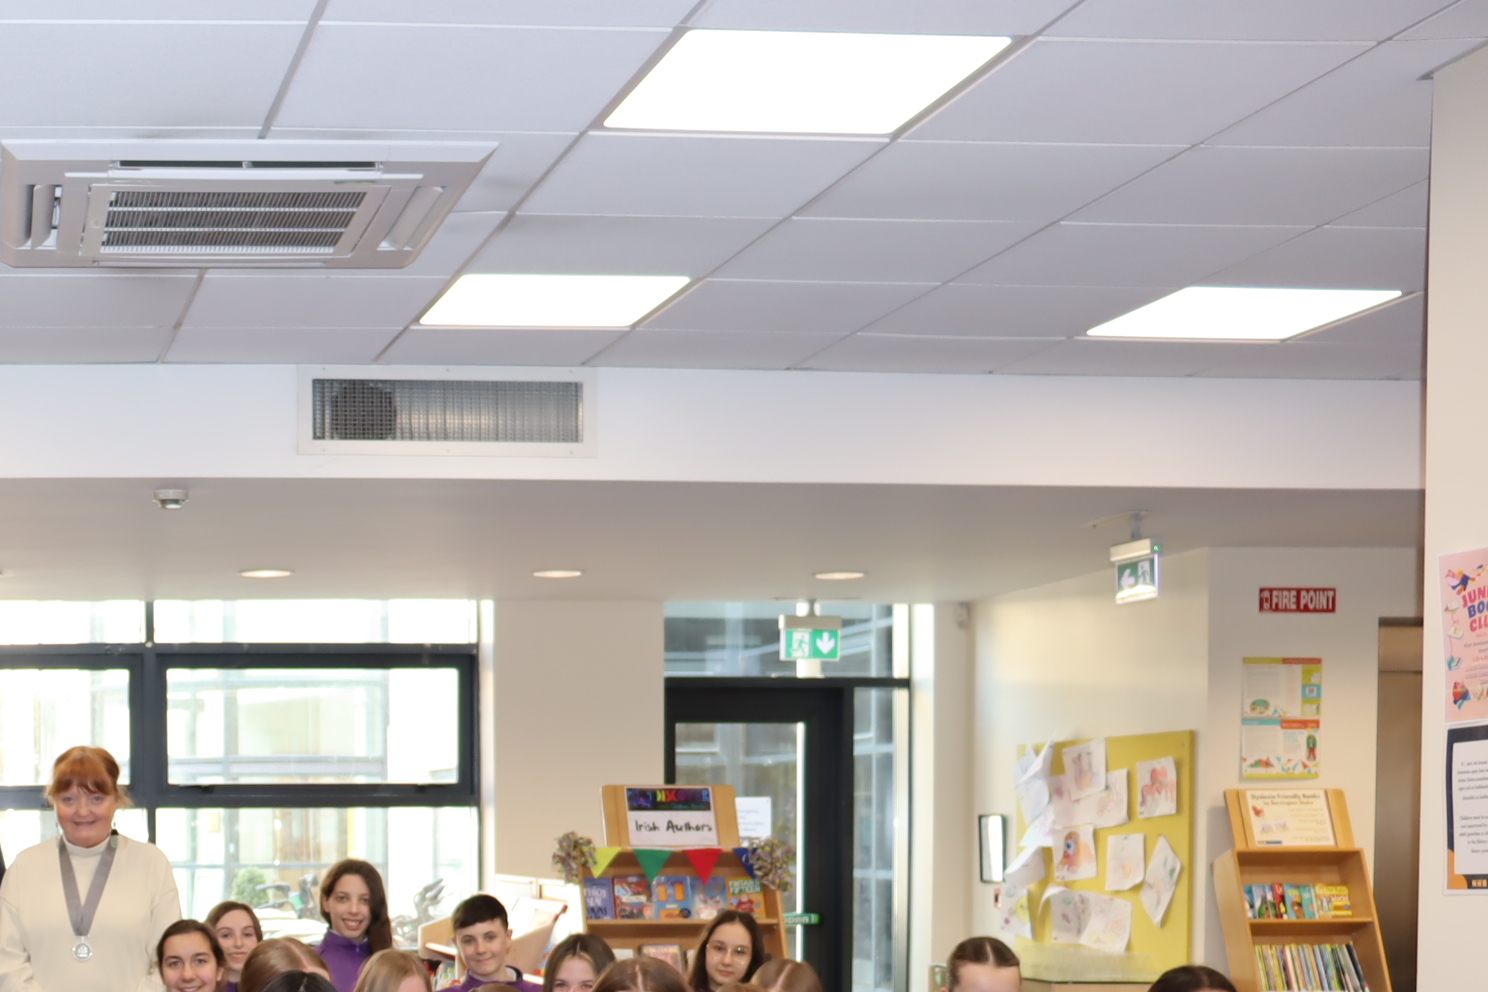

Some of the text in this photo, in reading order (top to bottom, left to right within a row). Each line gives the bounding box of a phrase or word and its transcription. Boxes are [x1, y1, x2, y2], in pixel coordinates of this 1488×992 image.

[1272, 590, 1334, 609] FIRE POINT
[635, 819, 713, 834] Irish Authors
